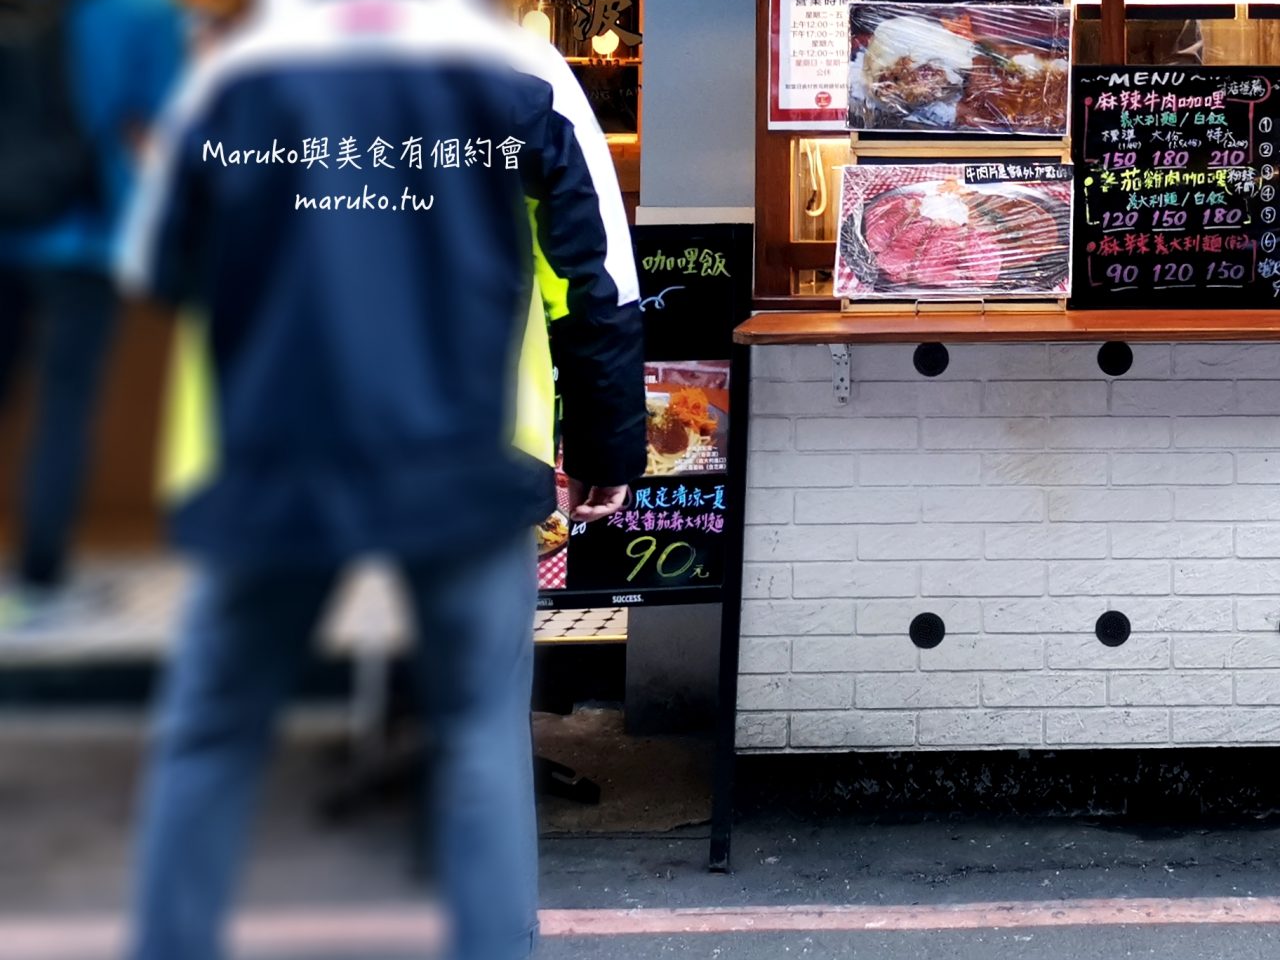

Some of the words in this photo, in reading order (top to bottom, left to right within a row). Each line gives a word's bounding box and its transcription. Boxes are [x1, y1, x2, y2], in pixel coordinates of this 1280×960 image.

[1109, 72, 1185, 87] MENU
[1095, 90, 1226, 112] 麻辣牛肉咖哩
[1102, 151, 1137, 170] 150
[1152, 150, 1189, 167] 180
[1208, 150, 1245, 167] 210
[1102, 211, 1139, 228] 120
[1152, 210, 1187, 227] 150
[1202, 208, 1242, 225] 180
[642, 248, 731, 277] 咖哩飯
[1106, 263, 1139, 283] 90
[1153, 263, 1194, 282] 120
[1206, 261, 1245, 280] 150
[634, 484, 726, 510] 限定清涼一夏
[626, 535, 696, 582] 90
